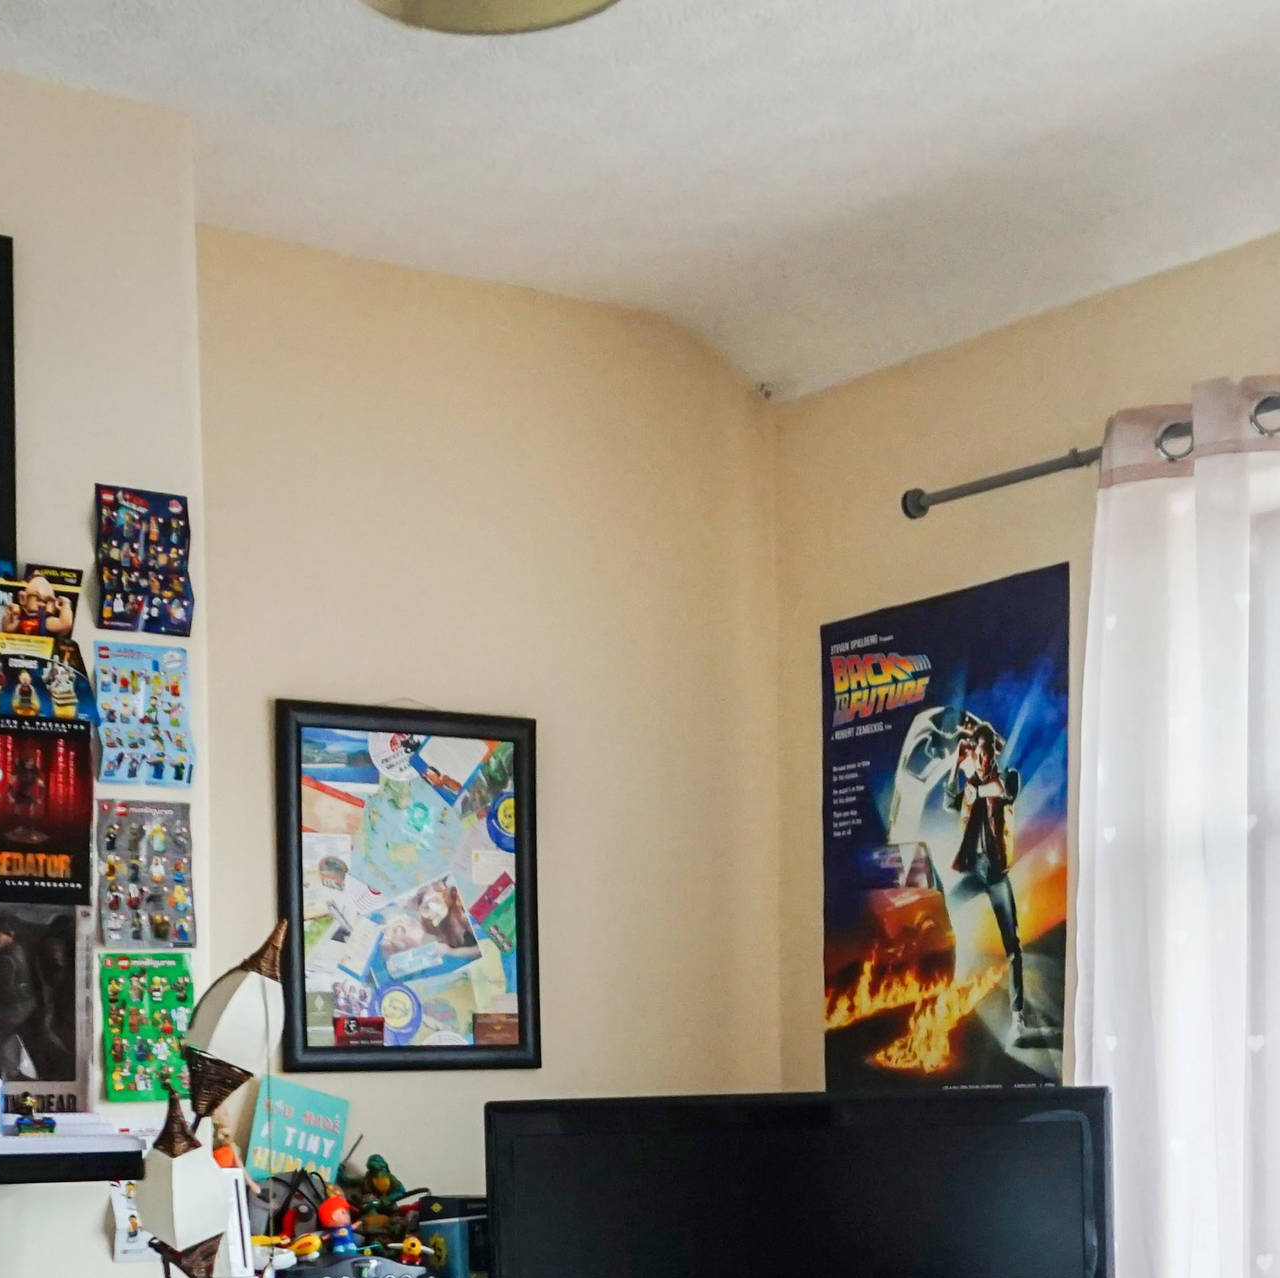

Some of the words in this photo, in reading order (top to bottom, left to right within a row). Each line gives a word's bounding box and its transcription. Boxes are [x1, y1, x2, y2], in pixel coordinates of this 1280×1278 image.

[831, 652, 914, 695] BACK
[848, 676, 930, 720] FUTURE
[303, 1110, 341, 1134] MADE
[283, 1126, 336, 1158] TINY
[253, 1146, 332, 1183] HUMAN
